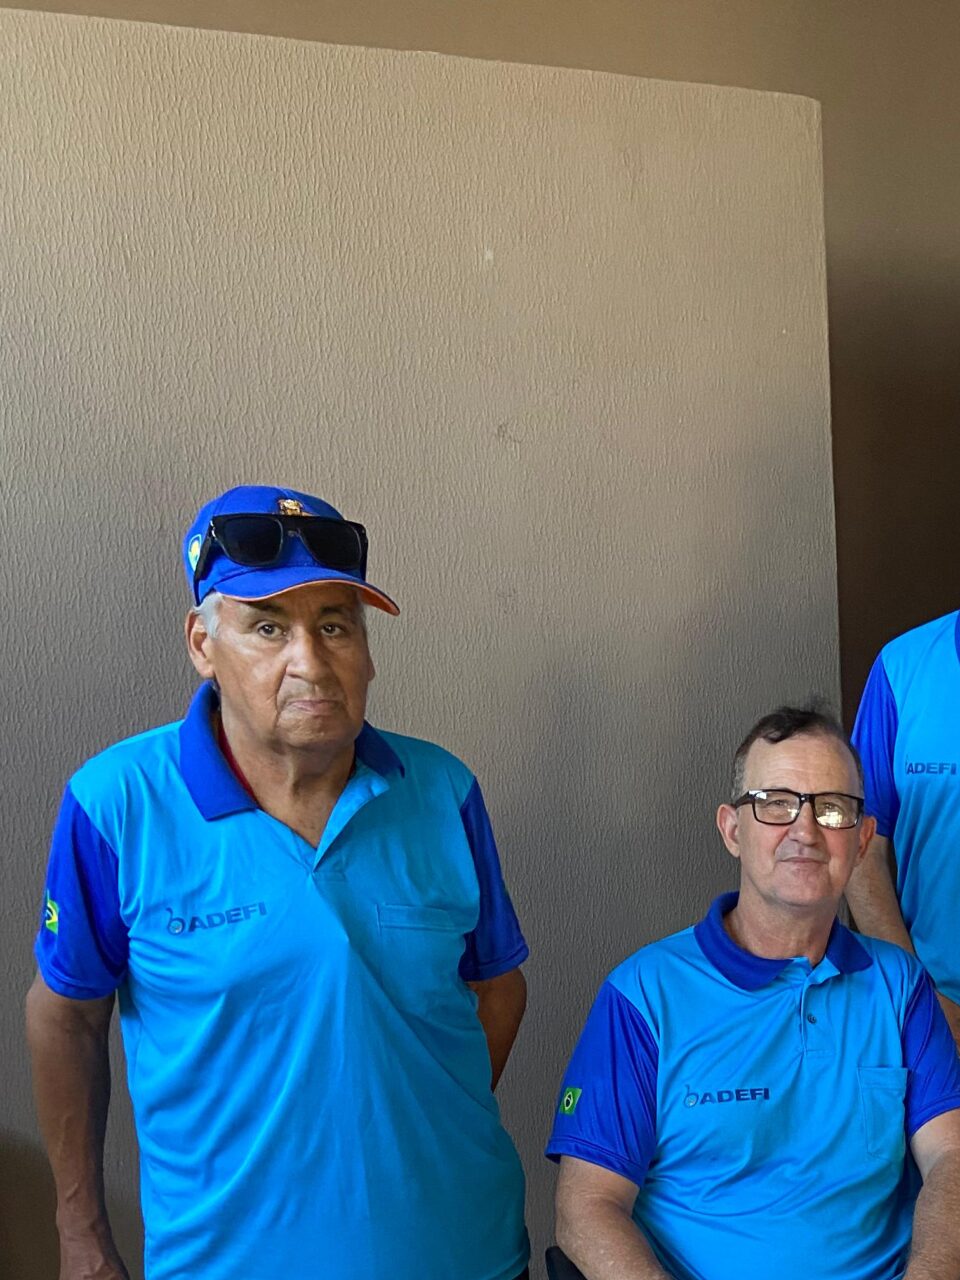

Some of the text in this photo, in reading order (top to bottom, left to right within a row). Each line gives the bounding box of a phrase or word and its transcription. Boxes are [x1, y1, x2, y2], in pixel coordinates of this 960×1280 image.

[905, 762, 957, 775] ADEFI
[188, 901, 268, 936] ADEFI
[701, 1087, 770, 1105] ADEFI
